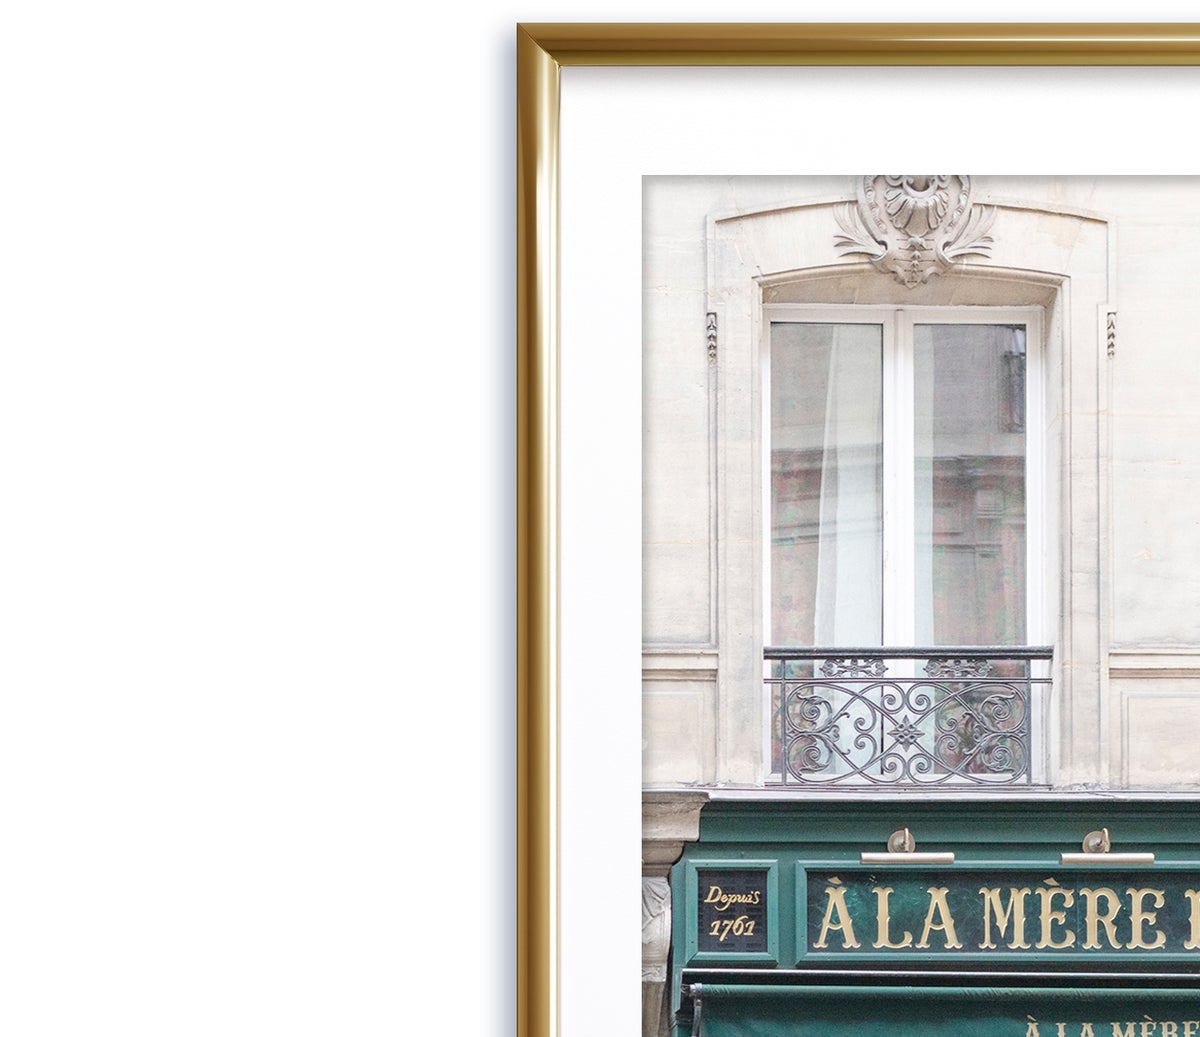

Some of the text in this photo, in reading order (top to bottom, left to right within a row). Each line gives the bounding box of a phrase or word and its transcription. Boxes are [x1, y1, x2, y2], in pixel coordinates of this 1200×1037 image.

[704, 886, 760, 911] Depuis
[812, 876, 861, 950] À
[872, 886, 963, 950] LA
[978, 877, 1166, 951] MÈRE
[709, 915, 755, 941] 1761
